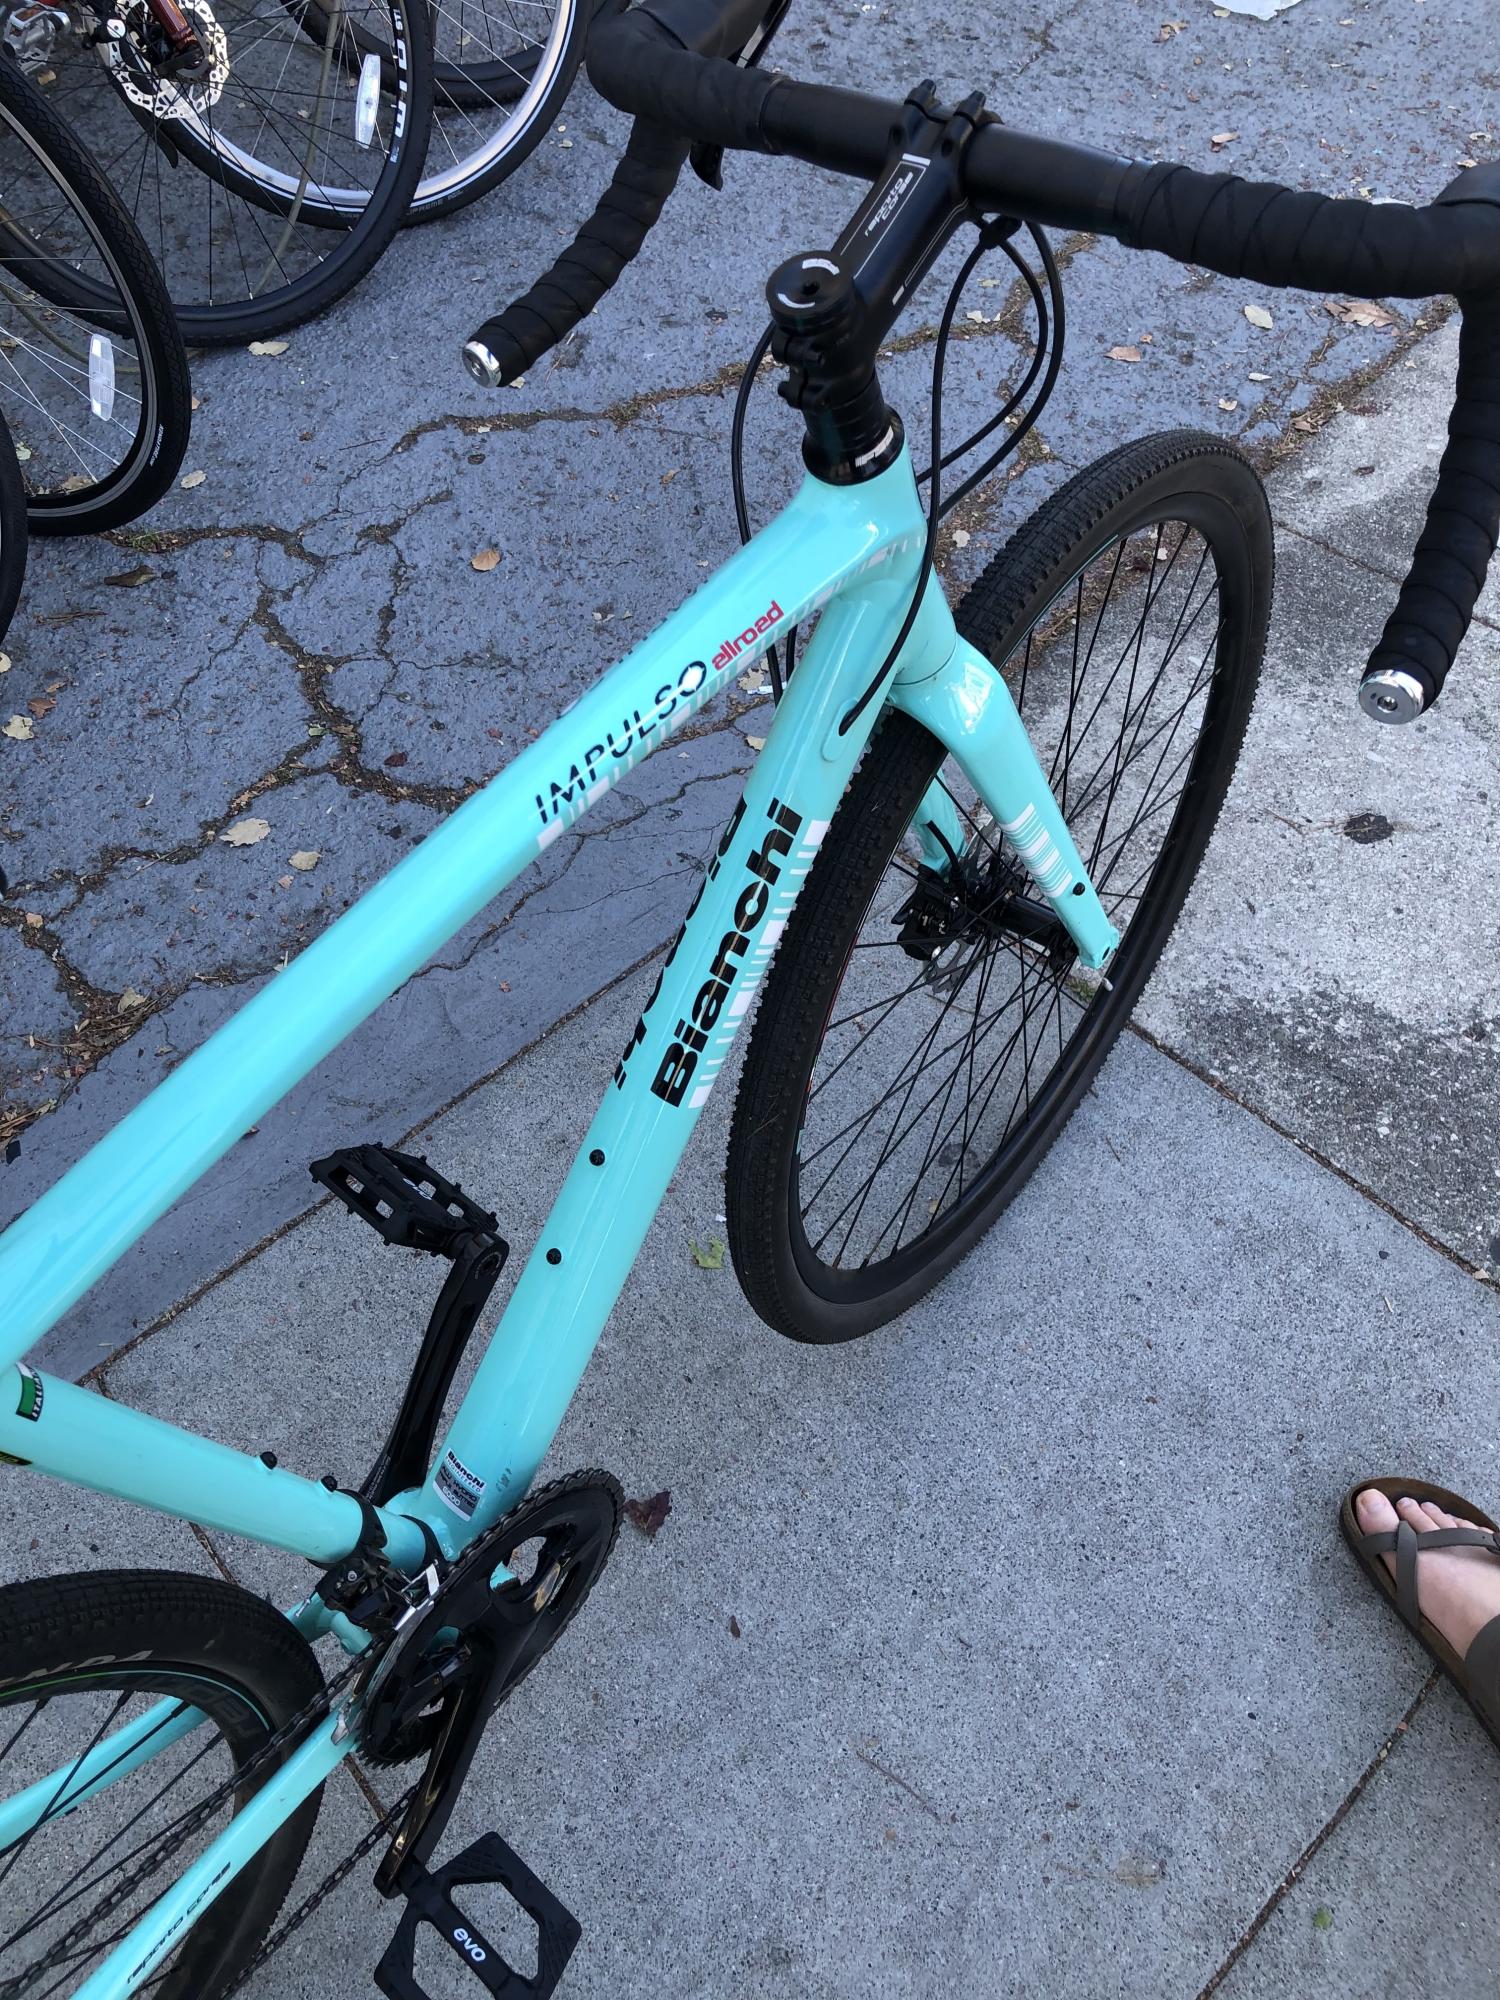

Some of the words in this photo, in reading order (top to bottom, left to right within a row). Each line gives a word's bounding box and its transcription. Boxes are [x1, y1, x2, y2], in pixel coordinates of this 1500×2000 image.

[535, 660, 708, 824] IMPULSO
[711, 600, 785, 672] allroad
[650, 797, 803, 1108] Bianchi
[448, 1451, 484, 1488] Bianchi
[453, 1927, 486, 1962] evo
